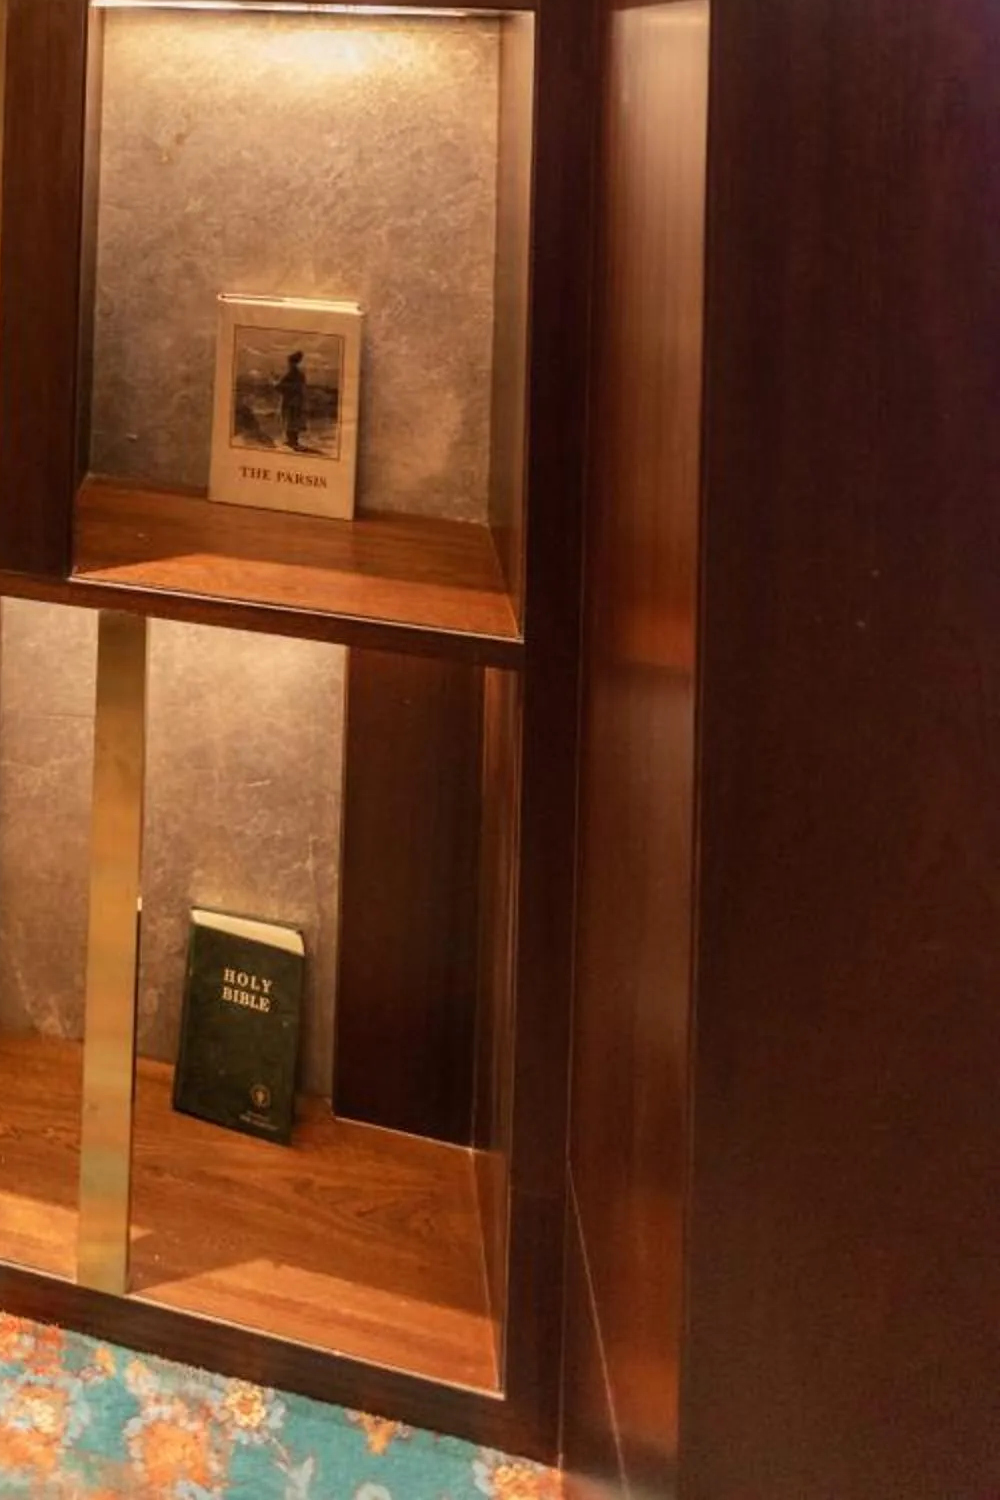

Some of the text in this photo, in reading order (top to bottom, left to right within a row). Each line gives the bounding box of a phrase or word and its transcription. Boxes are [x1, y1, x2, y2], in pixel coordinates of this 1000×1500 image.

[239, 466, 271, 480] THE
[223, 968, 273, 993] HOLY
[222, 987, 271, 1013] BIBLE
